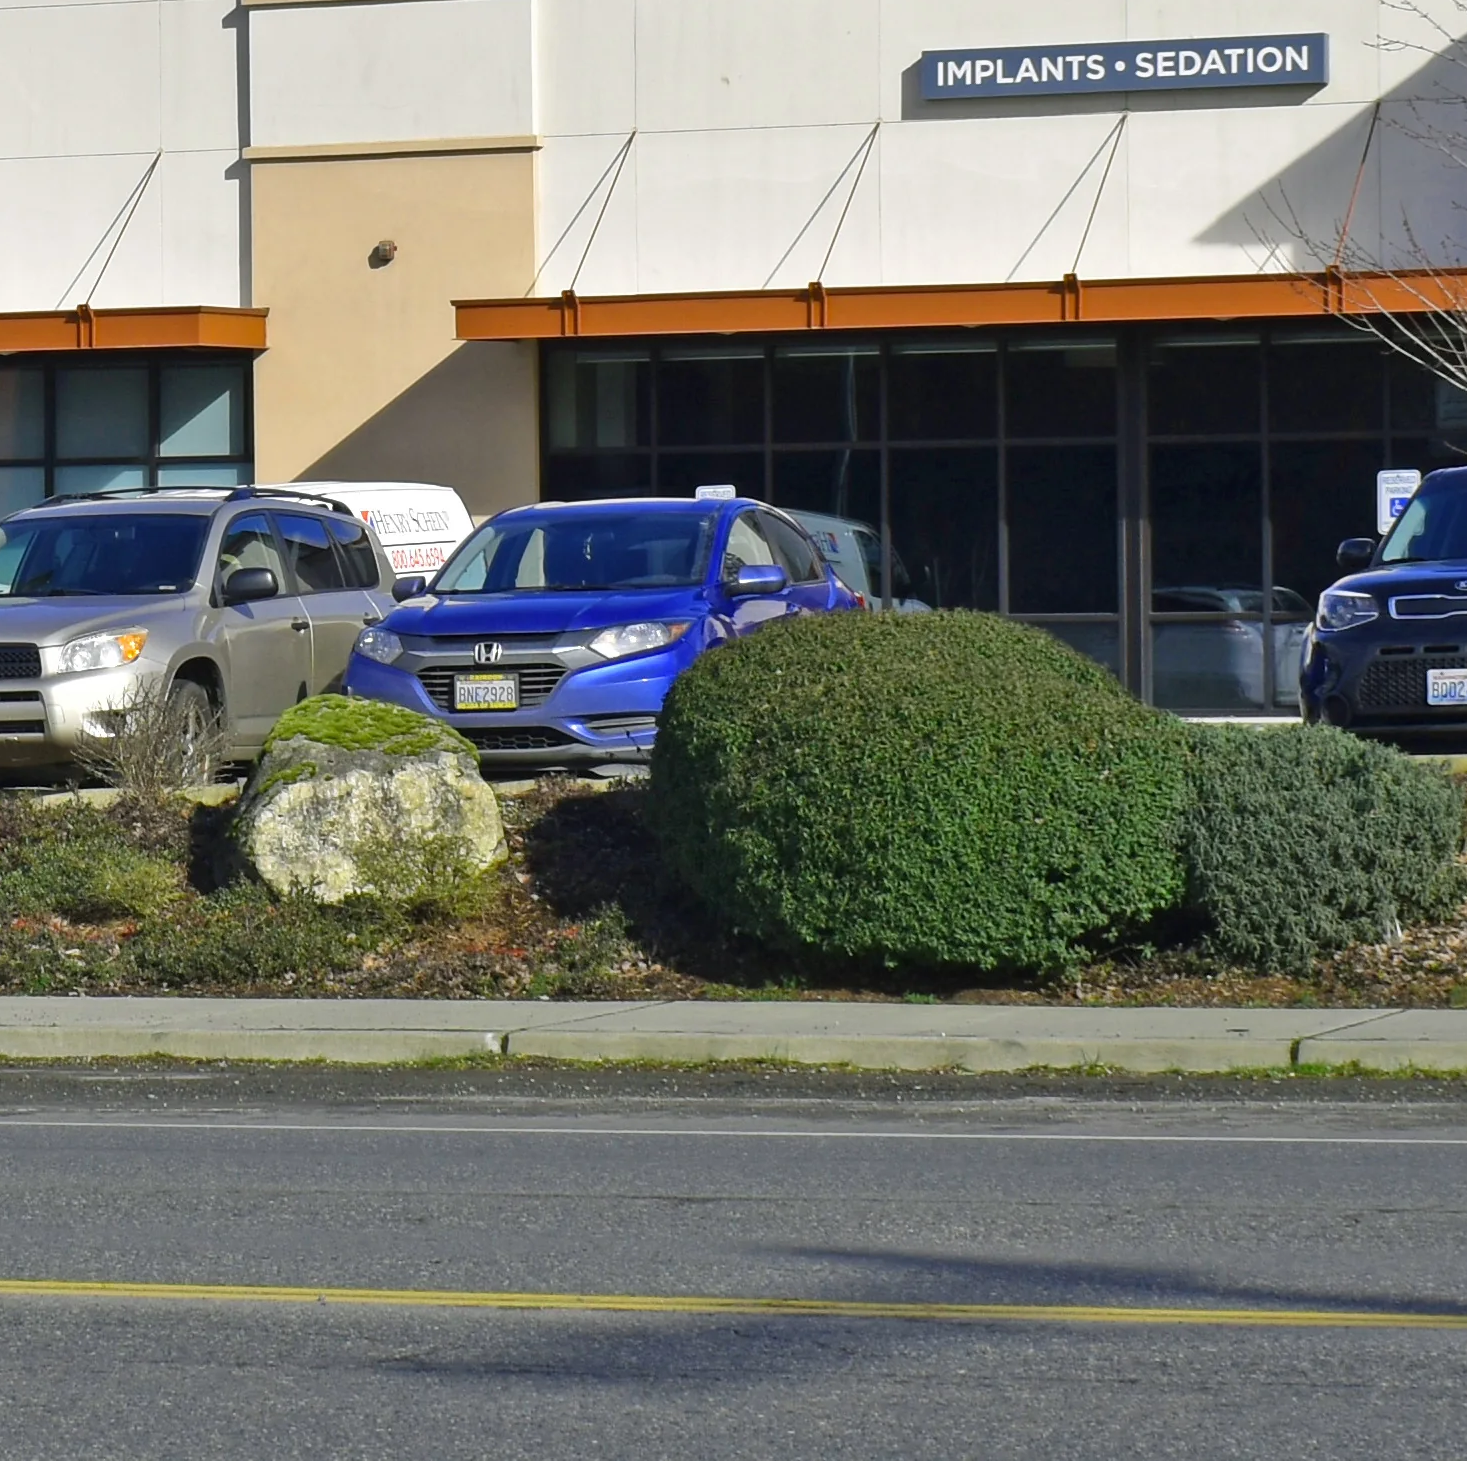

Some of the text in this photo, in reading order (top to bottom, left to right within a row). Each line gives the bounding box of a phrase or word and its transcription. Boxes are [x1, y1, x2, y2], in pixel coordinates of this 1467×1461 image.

[936, 53, 1106, 87] IMPLANTS
[1134, 44, 1309, 79] SEDATION
[371, 510, 412, 535] HENRY
[458, 686, 514, 704] BNE2928
